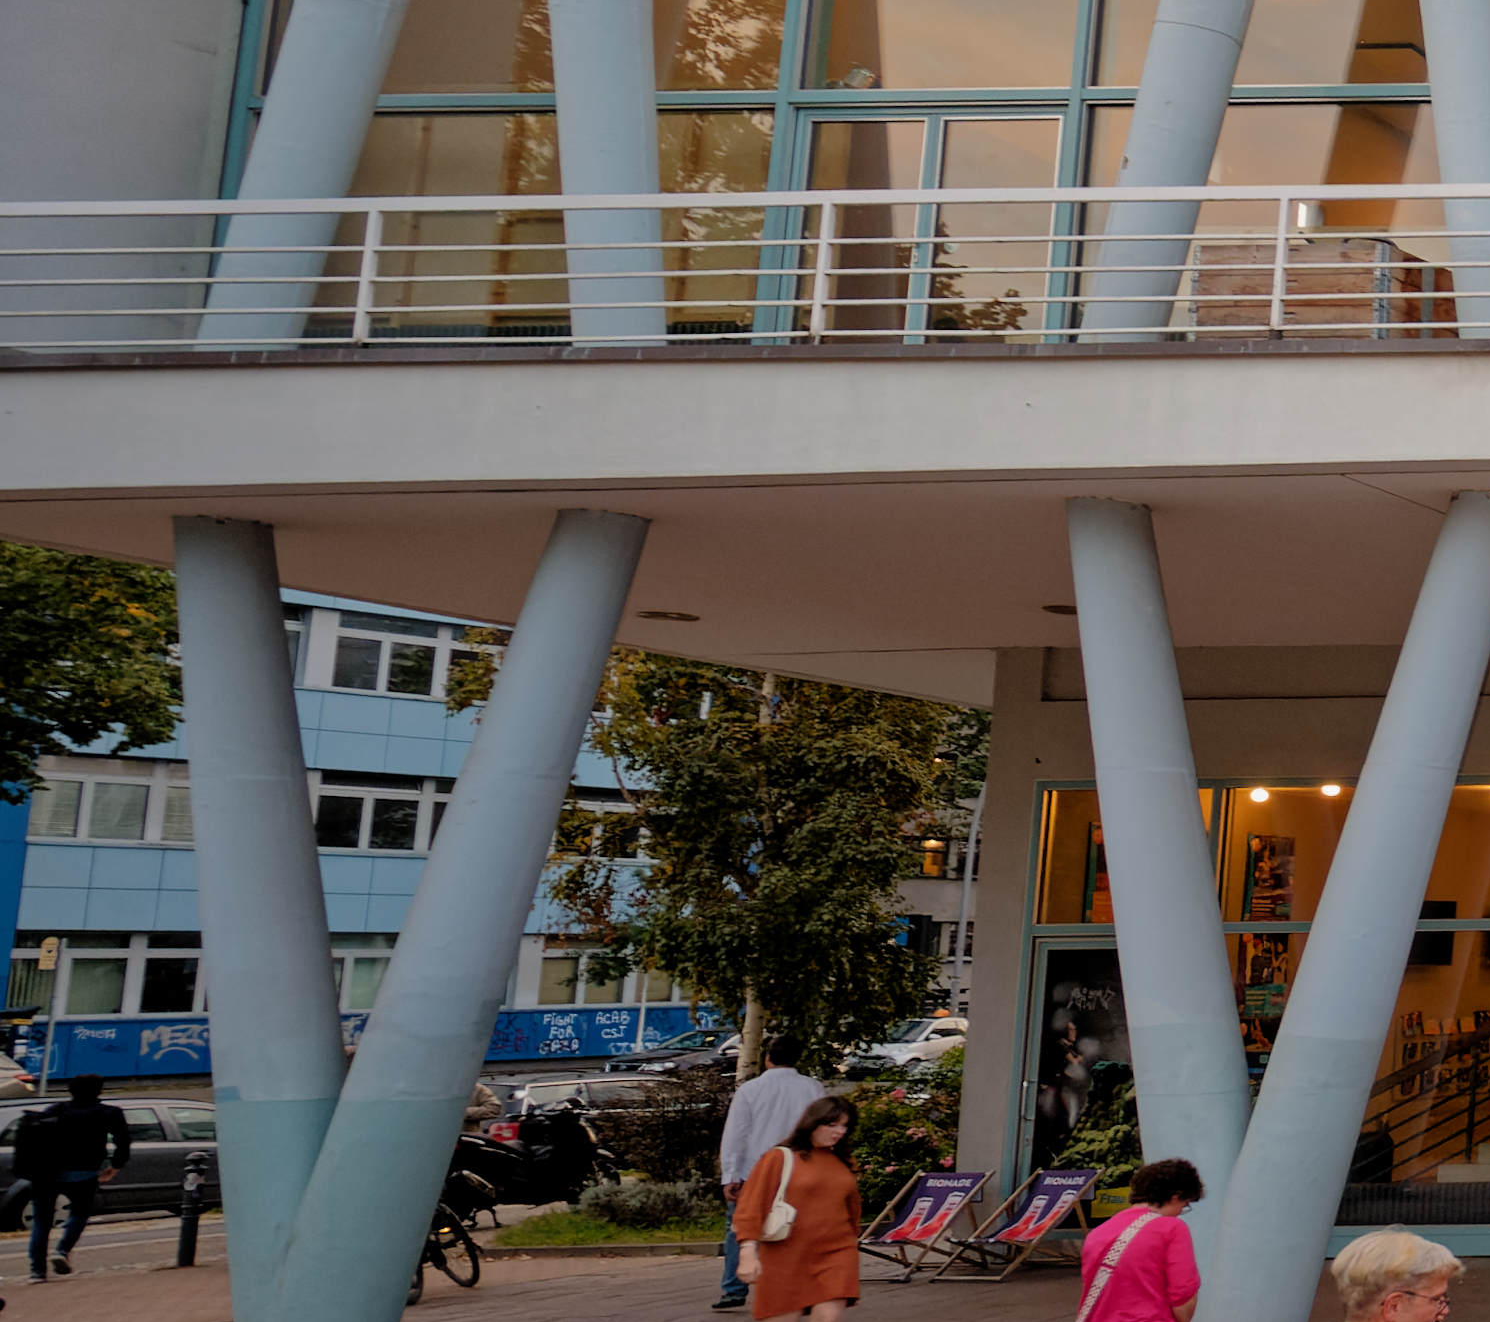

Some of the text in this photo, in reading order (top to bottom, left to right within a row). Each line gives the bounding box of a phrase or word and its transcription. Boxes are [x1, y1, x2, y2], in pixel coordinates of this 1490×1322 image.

[543, 1012, 579, 1025] FIGHT
[549, 1025, 575, 1039] FOR
[926, 1178, 972, 1187] BIONADE
